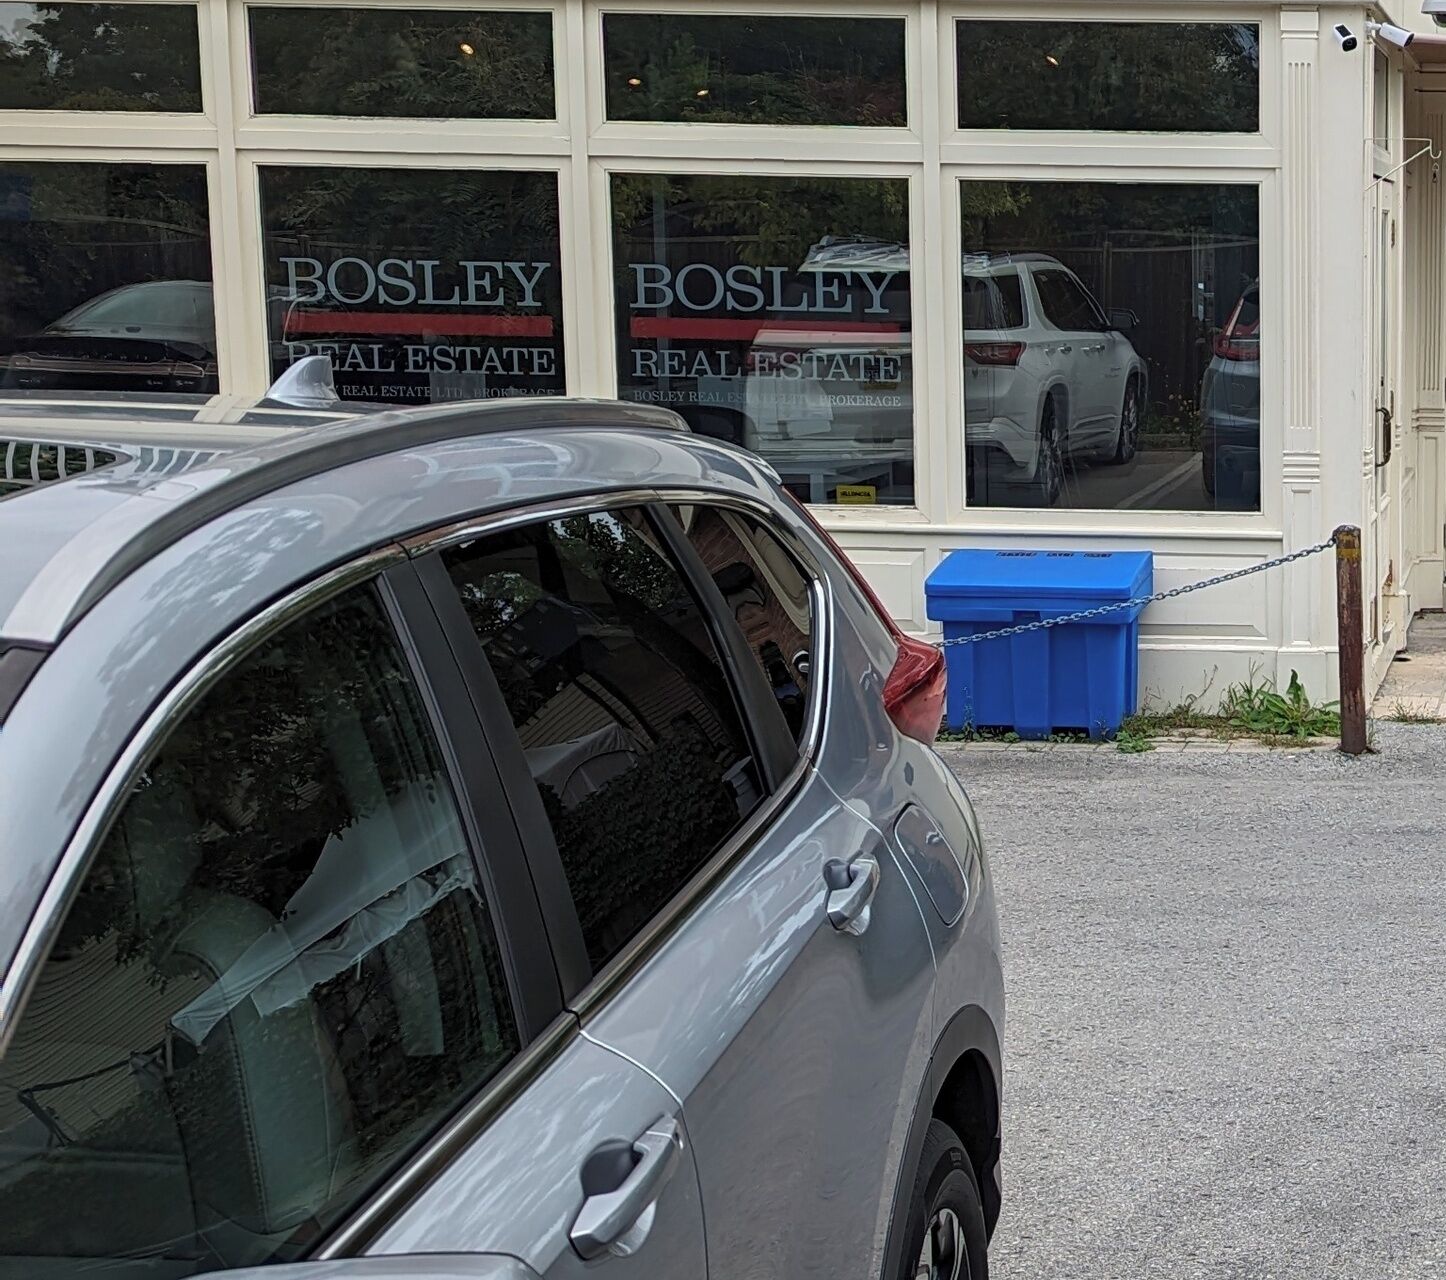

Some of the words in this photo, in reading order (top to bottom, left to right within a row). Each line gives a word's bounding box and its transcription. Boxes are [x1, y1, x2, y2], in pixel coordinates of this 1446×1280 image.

[279, 257, 551, 307] BOSLEY
[628, 263, 900, 314] BOSLEY
[403, 345, 556, 376] ESTATE
[631, 348, 741, 378] REAL
[750, 350, 901, 383] ESTATE
[342, 385, 378, 397] REAL
[381, 386, 432, 398] ESTATE
[633, 391, 685, 402] BOSLEY
[689, 391, 724, 403] REAL
[820, 394, 902, 407] BROKERAGE
